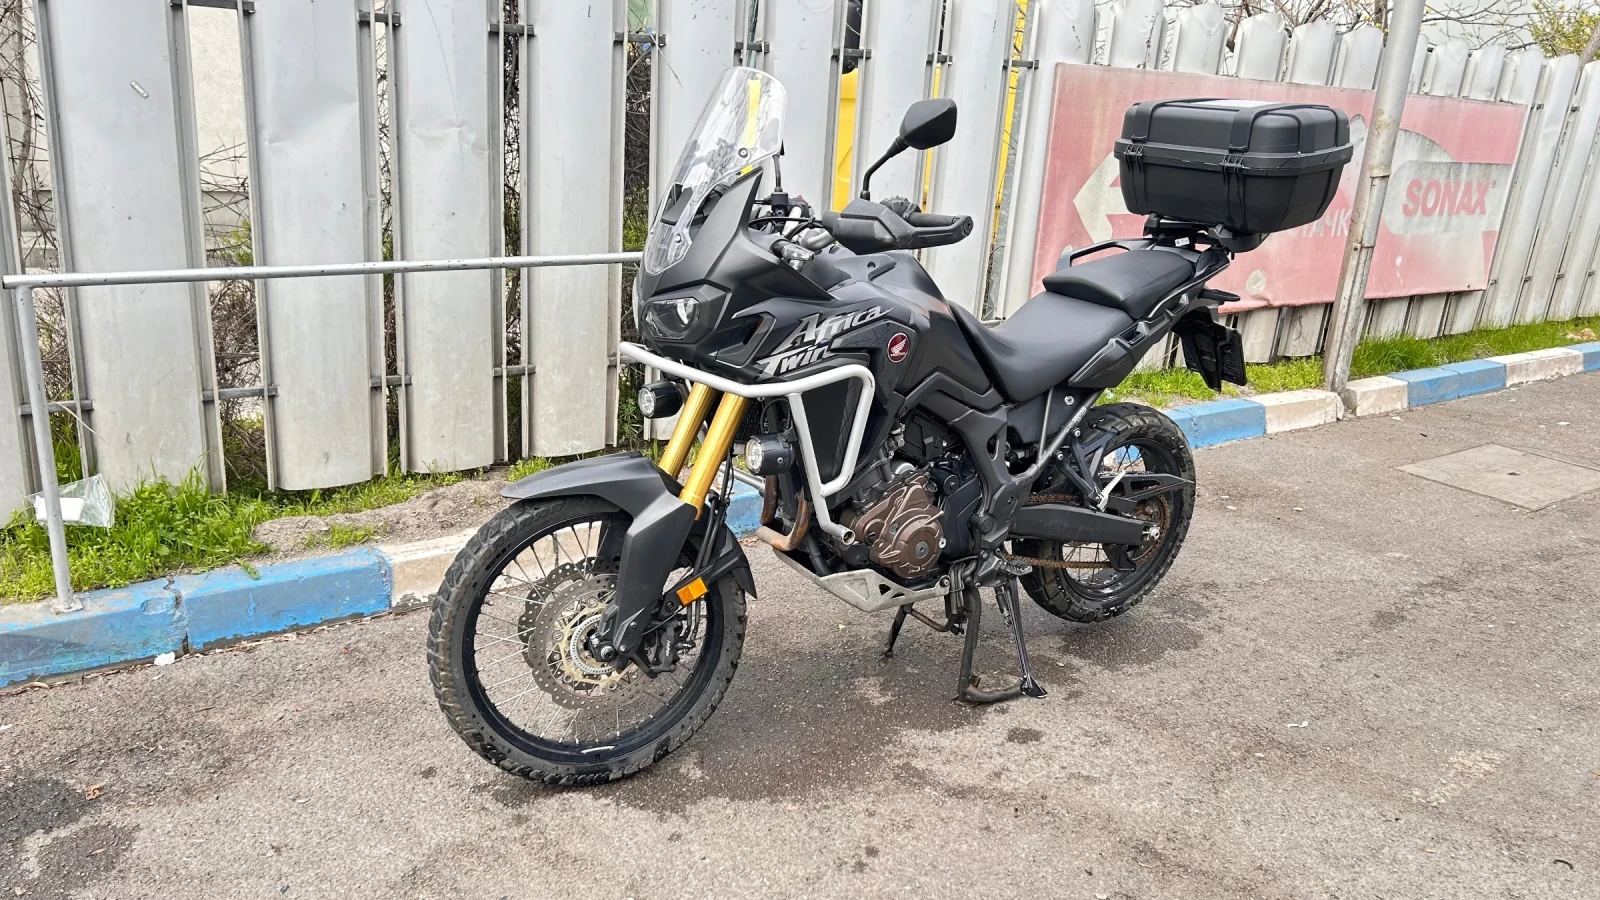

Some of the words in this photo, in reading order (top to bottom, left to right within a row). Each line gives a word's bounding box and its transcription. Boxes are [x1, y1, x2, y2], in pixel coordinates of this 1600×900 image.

[1402, 178, 1492, 217] SONAX
[770, 305, 897, 355] Africa
[756, 344, 838, 381] Twin
